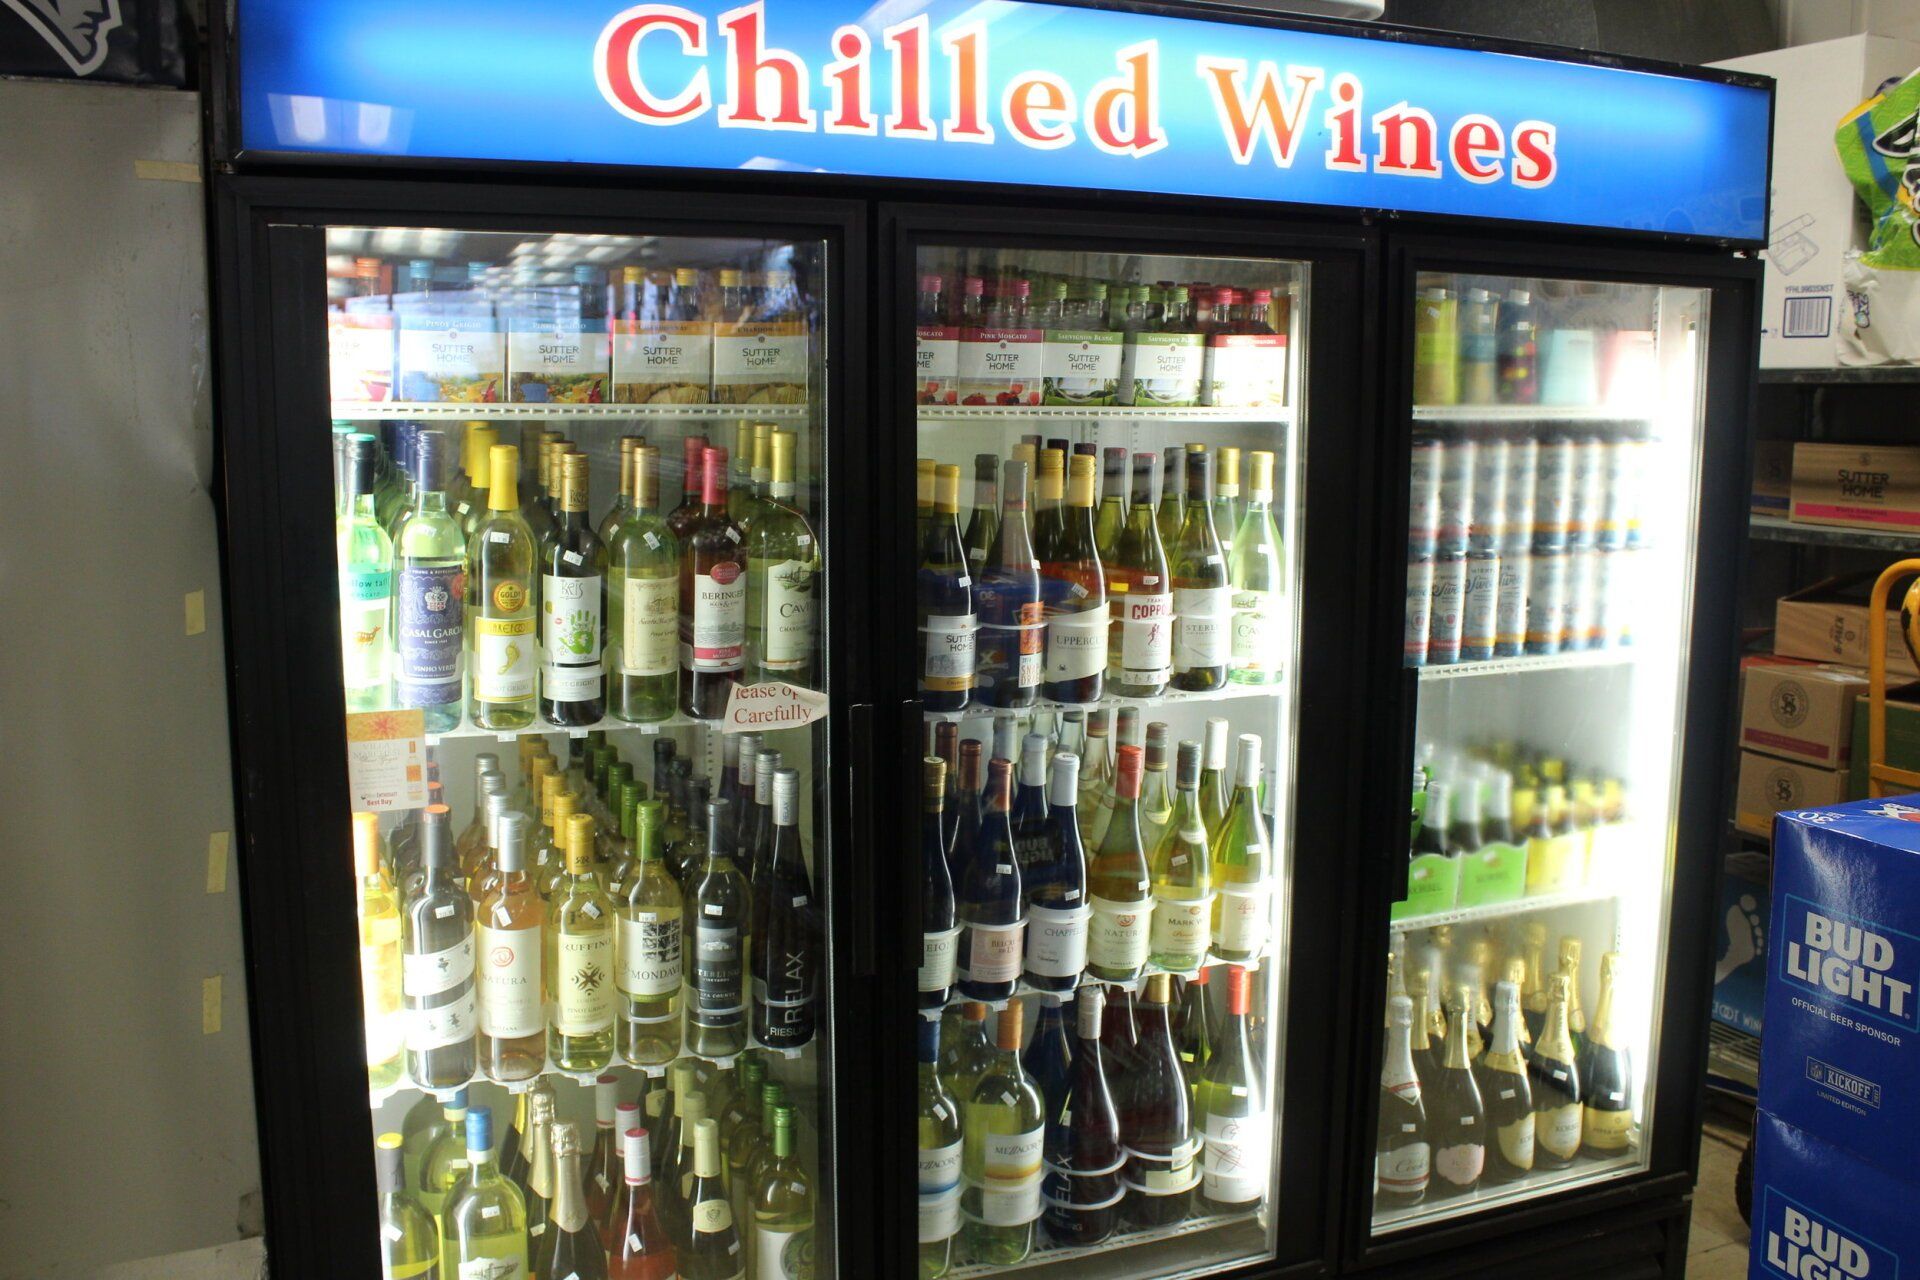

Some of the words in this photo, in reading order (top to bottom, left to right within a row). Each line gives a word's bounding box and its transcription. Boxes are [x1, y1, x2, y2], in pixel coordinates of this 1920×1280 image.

[592, 1, 1168, 159] Chilled
[1197, 55, 1558, 189] Wines
[432, 343, 474, 354] SUTTER
[539, 344, 580, 354] SUTTER
[642, 346, 682, 356] SUTTER
[742, 347, 780, 357] SUTTER
[436, 353, 471, 363] HOME
[543, 354, 575, 364] HOME
[647, 356, 678, 365] HOME
[747, 357, 776, 366] HOME
[985, 353, 1019, 362] SUTTER
[1068, 353, 1100, 362] SUTTER
[1157, 355, 1186, 364] SUTTER
[989, 362, 1015, 371] HOME
[1071, 362, 1096, 371] HOME
[1160, 364, 1183, 372] HOME
[1837, 469, 1890, 485] SUTTER
[1842, 484, 1884, 498] HOME
[1132, 604, 1166, 620] COPPO
[401, 627, 432, 638] CASAL
[946, 633, 975, 643] SUTTER
[949, 643, 973, 652] HOME
[413, 664, 438, 672] VINHO
[735, 686, 776, 700] lease
[734, 704, 812, 723] Carefully
[1168, 918, 1194, 926] MARK
[1104, 928, 1139, 938] NATUR
[1805, 911, 1894, 971] BUD
[481, 973, 528, 985] NATURA
[1787, 941, 1912, 1017] LIGHT
[784, 951, 805, 1024] RELAX
[1791, 997, 1829, 1018] OFFICIAL
[1830, 1012, 1853, 1028] BEER
[1854, 1022, 1901, 1046] SPONSOR
[769, 1027, 801, 1037] RIESL
[1827, 1070, 1871, 1099] KICKOFF
[1816, 1090, 1841, 1105] LIMITED
[1841, 1101, 1866, 1116] EDITION
[1784, 1206, 1870, 1278] BUD
[1767, 1231, 1855, 1280] LIG
